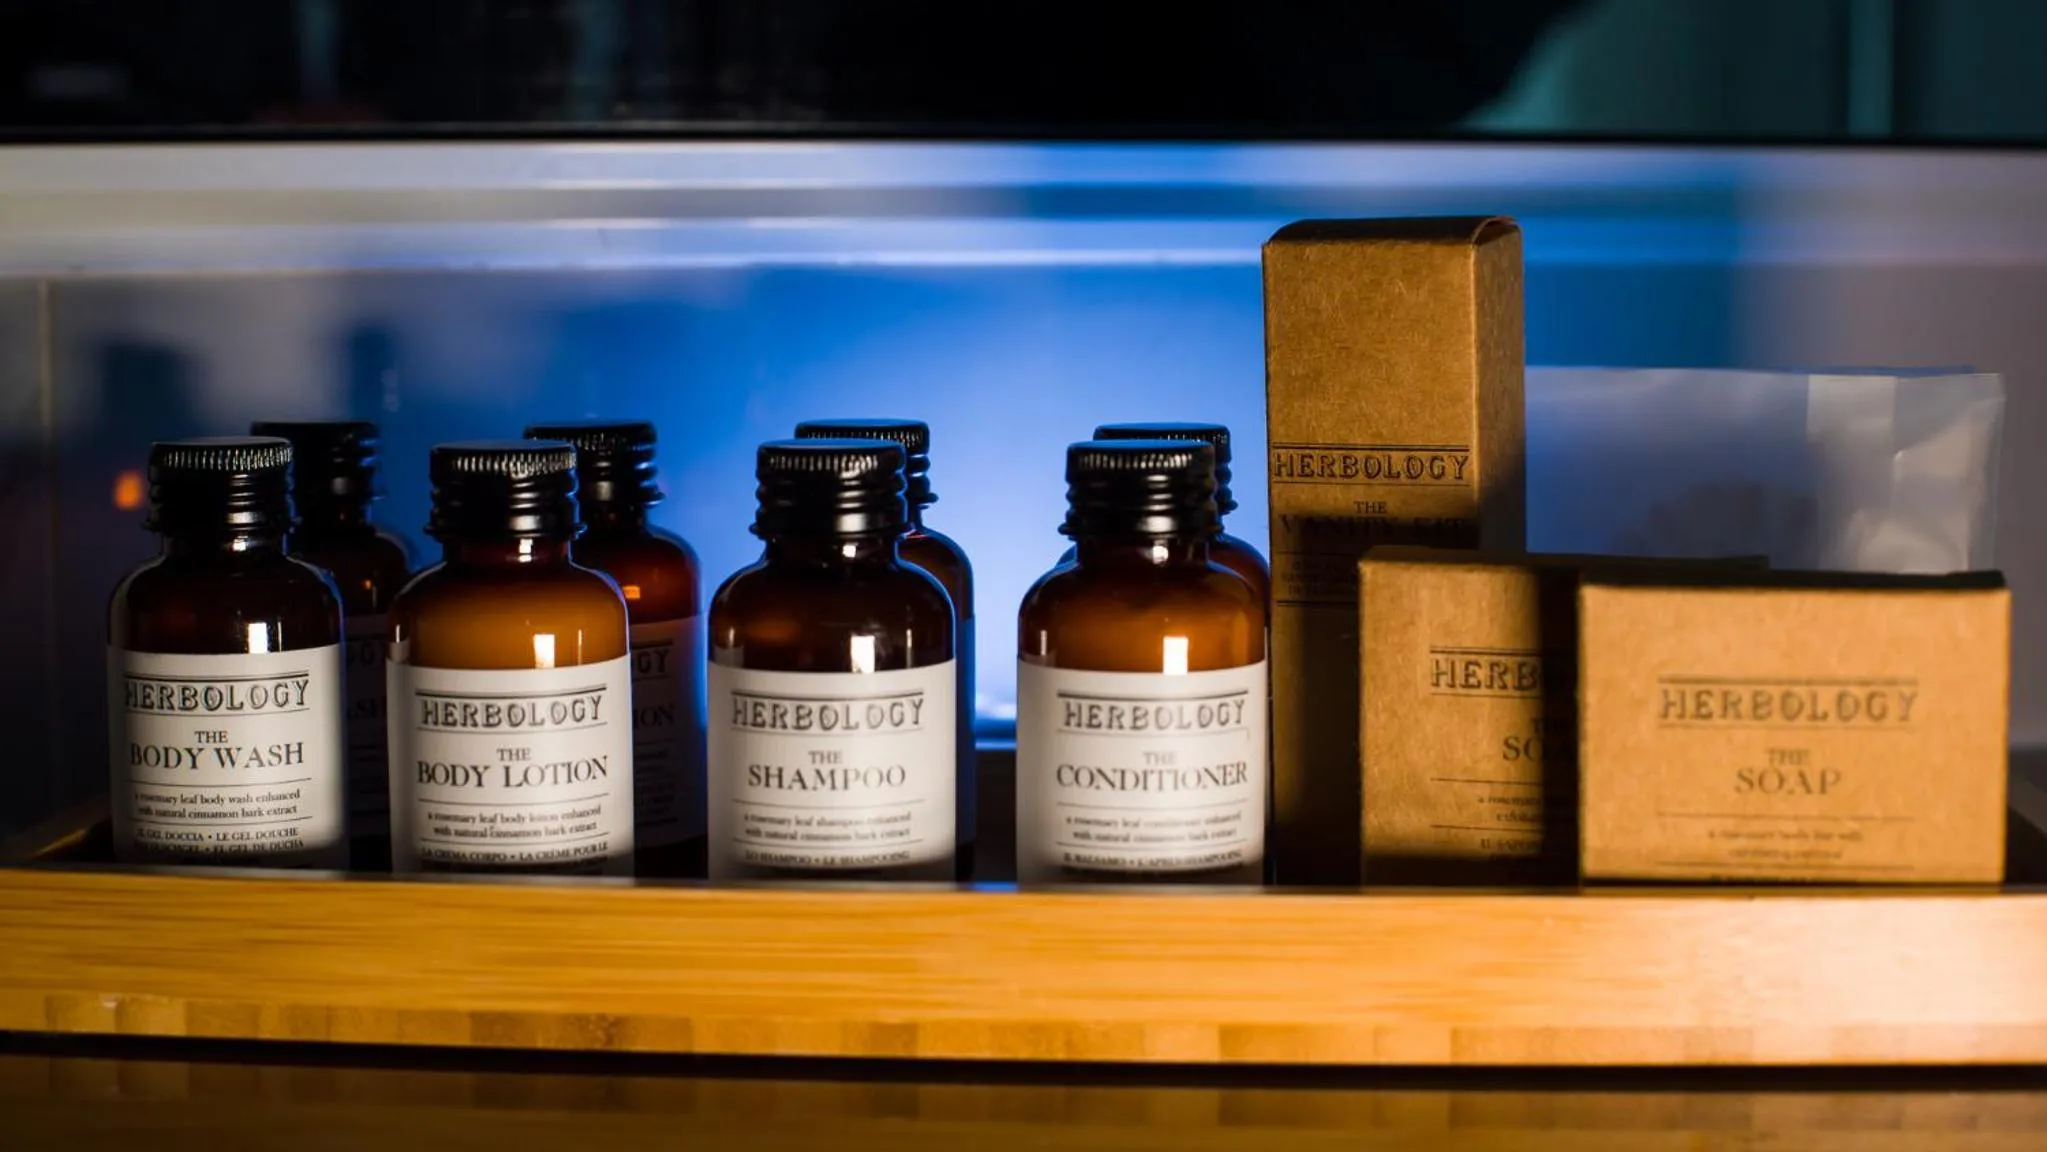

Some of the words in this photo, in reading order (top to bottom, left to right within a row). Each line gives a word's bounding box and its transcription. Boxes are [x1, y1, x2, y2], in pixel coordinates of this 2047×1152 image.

[1274, 453, 1470, 481] HERBOLOGY
[1354, 500, 1387, 514] THE
[124, 679, 310, 712] HERBOLOGY
[1659, 688, 1919, 722] HERBOLOGY
[421, 695, 603, 728] HERBOLOGY
[731, 697, 925, 731] HERBOLOGY
[1063, 699, 1246, 731] HERBOLOGY
[194, 731, 228, 744] THE
[130, 743, 205, 770] BODY
[211, 742, 304, 770] WASH
[497, 748, 531, 762] THE
[808, 750, 843, 765] THE
[1143, 751, 1177, 766] THE
[1765, 747, 1811, 765] THE
[417, 760, 492, 788] BODY
[503, 755, 608, 788] LOTION
[748, 764, 906, 791] SHAMPOO
[1056, 760, 1248, 792] CONDITIONER
[1733, 767, 1842, 796] SOAP
[180, 792, 198, 804] leaf
[199, 792, 225, 807] body
[228, 792, 253, 804] wash
[255, 787, 301, 802] enhanced
[241, 807, 265, 818] bark
[266, 804, 297, 816] extract
[478, 811, 498, 824] leaf
[499, 812, 525, 825] body
[163, 831, 205, 842] DOCCIA
[216, 831, 229, 842] LE
[231, 831, 253, 842] GEL
[255, 827, 300, 840] DOUCHE
